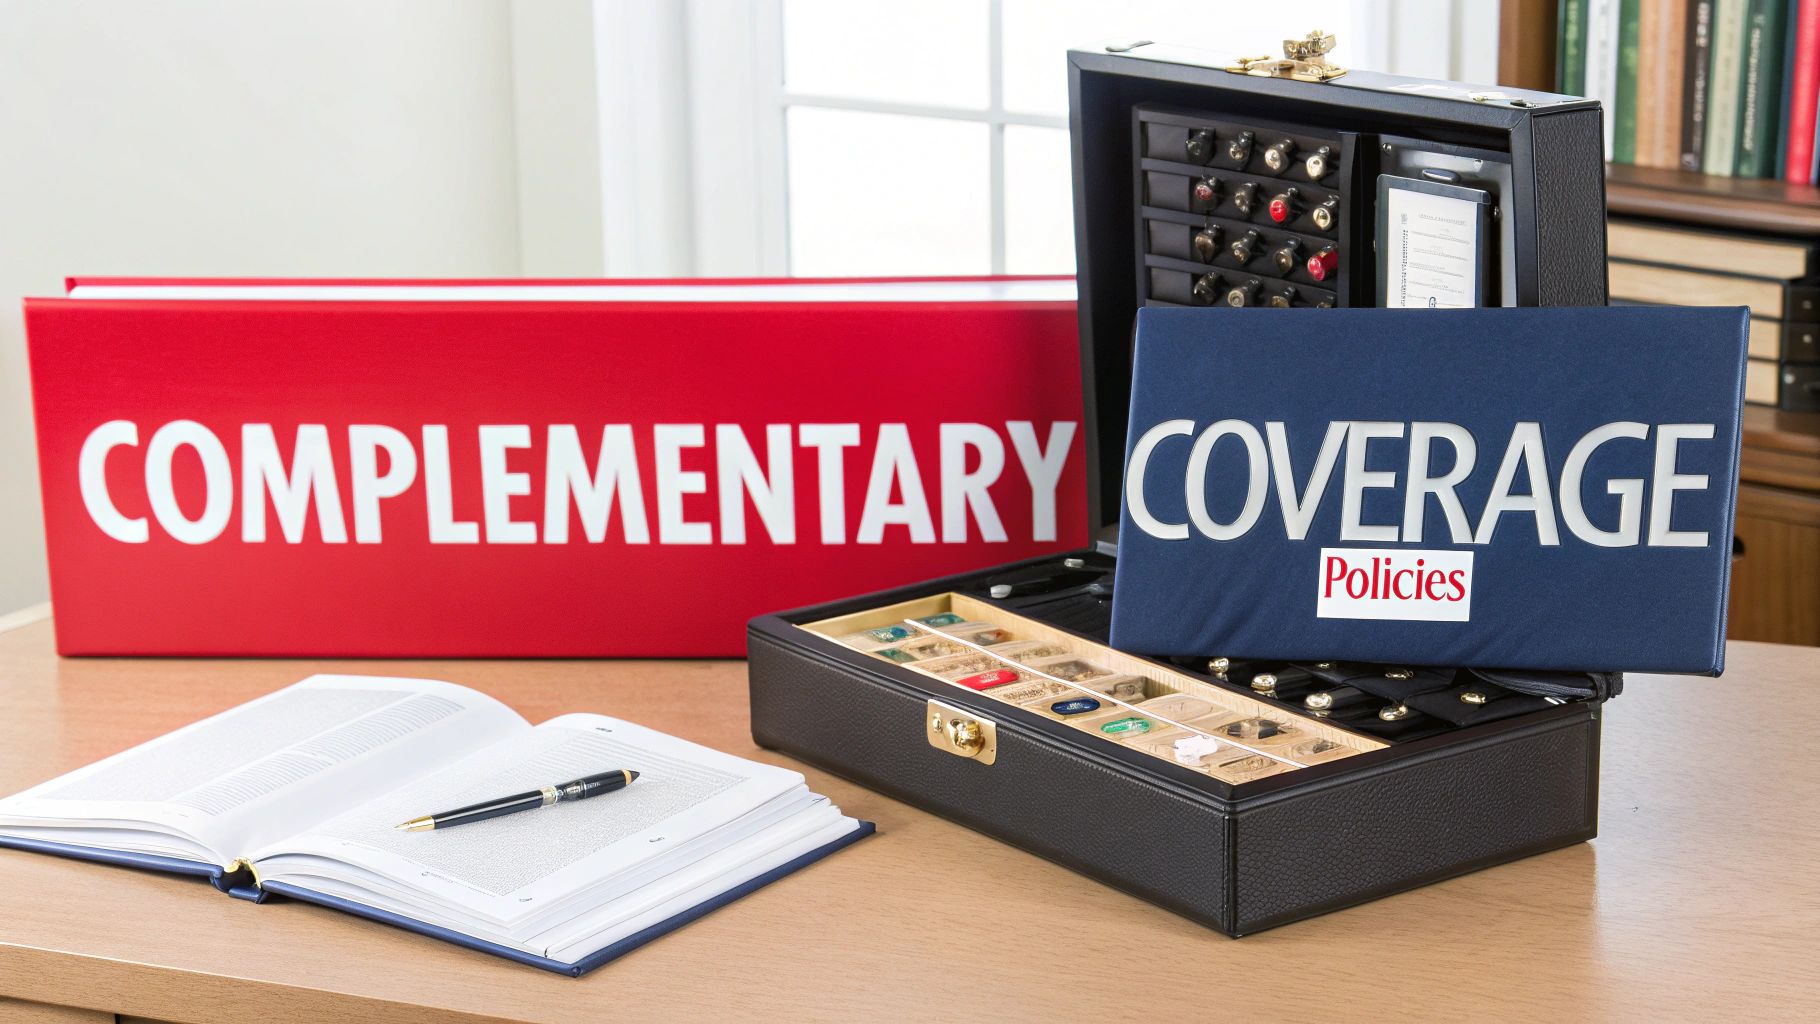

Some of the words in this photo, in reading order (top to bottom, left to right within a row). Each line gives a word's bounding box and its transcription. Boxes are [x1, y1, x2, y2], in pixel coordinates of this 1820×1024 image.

[78, 419, 1077, 545] COMPLEMENTARY
[1126, 419, 1716, 547] COVERAGE
[1324, 556, 1466, 602] Policies
